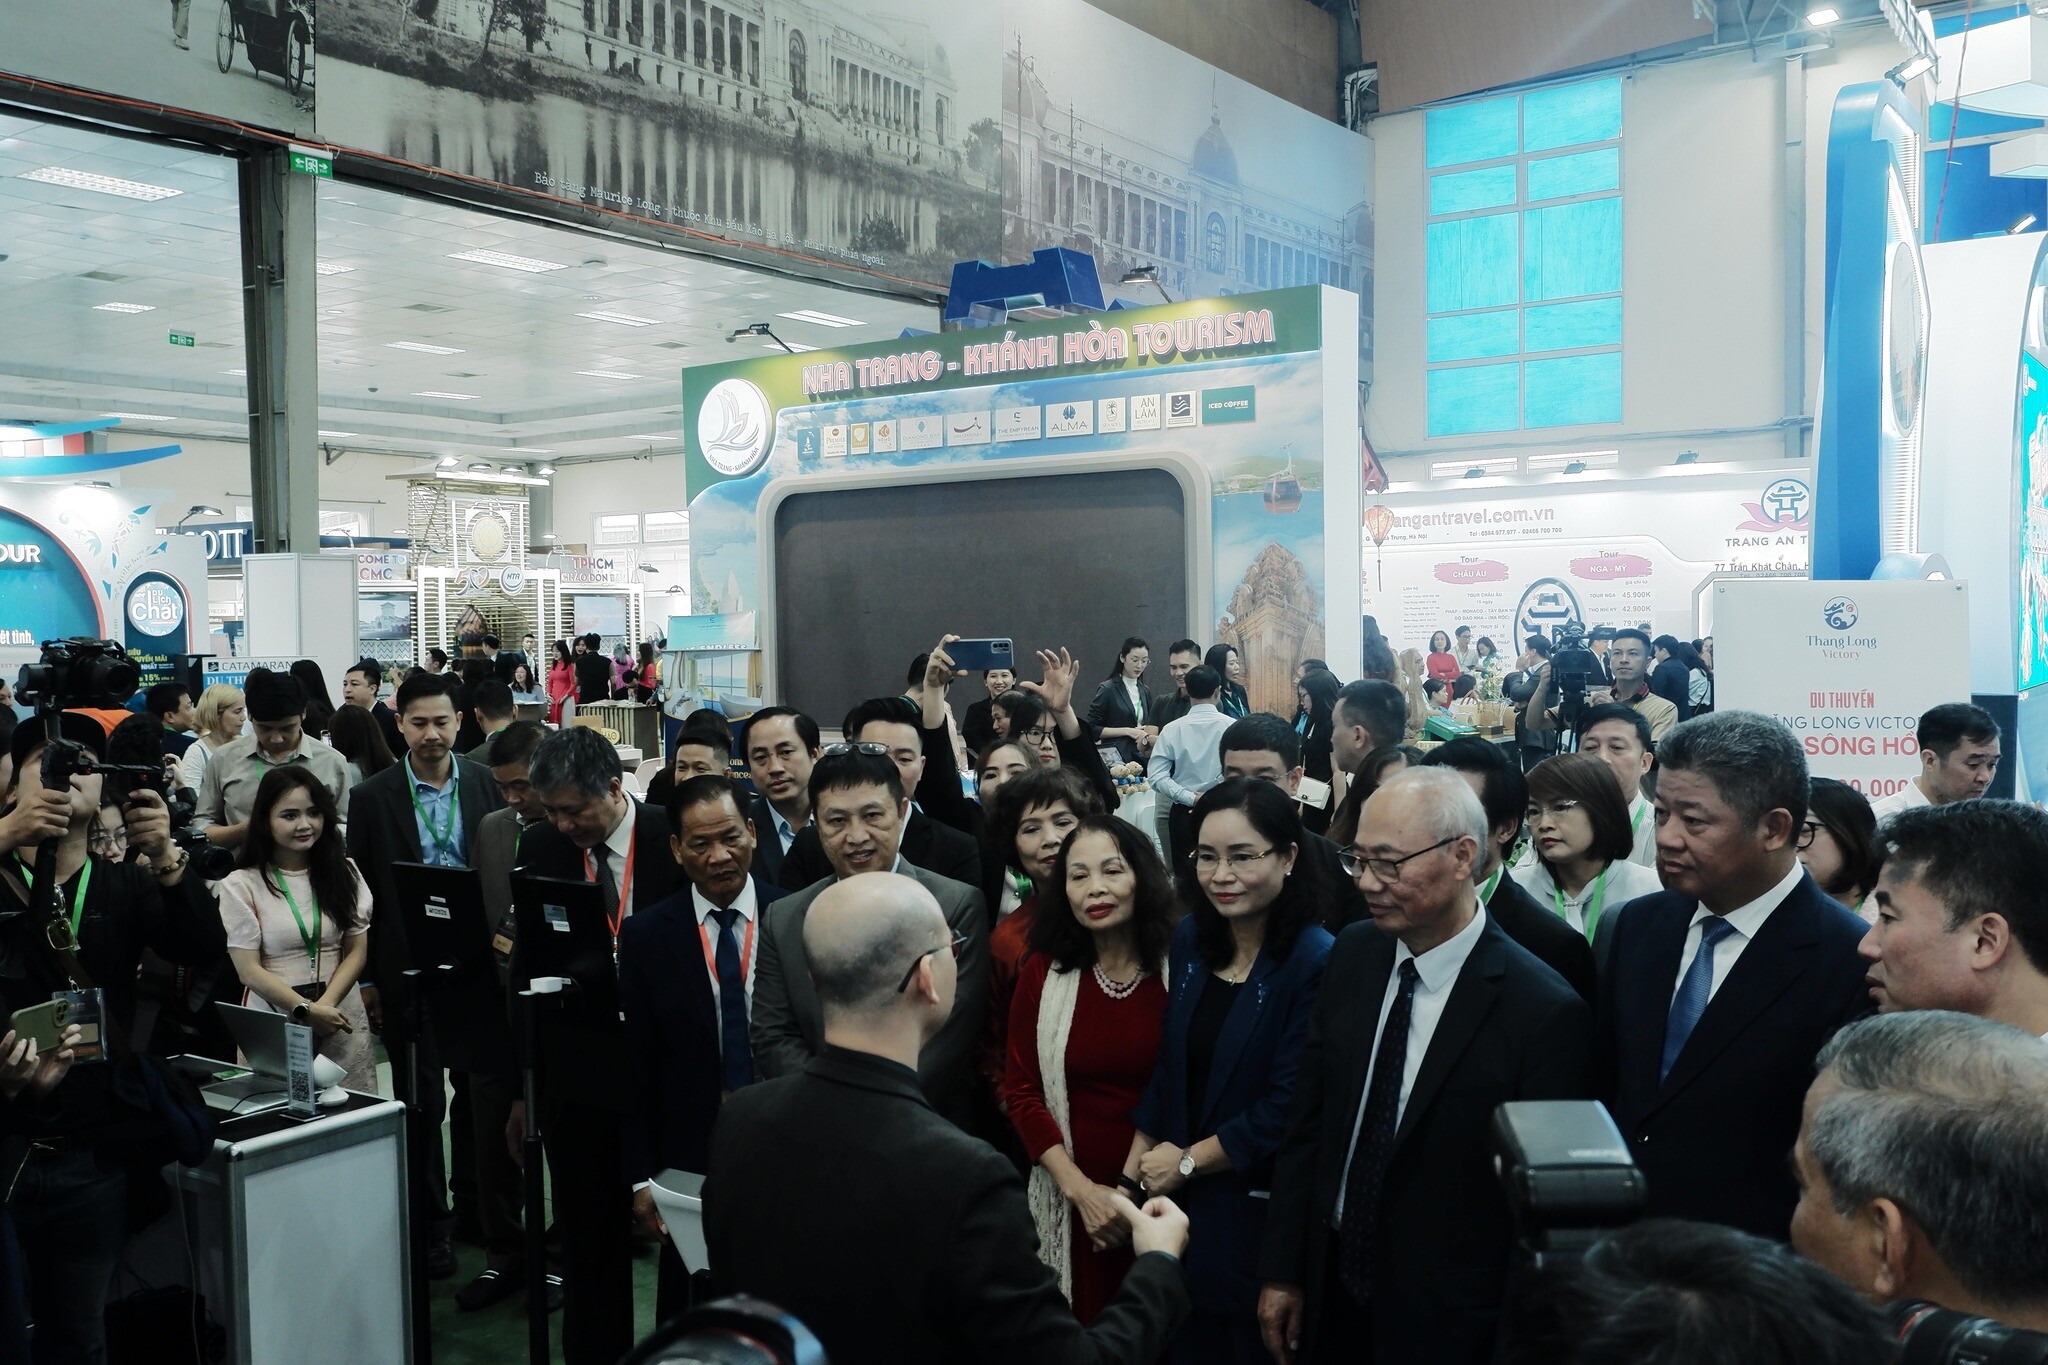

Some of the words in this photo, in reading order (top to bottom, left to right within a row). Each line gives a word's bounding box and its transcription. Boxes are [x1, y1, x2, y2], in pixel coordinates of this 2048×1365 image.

[535, 171, 556, 187] Bảo
[560, 179, 587, 198] tàng
[590, 186, 633, 206] Maurice
[637, 197, 661, 216] Long
[704, 213, 722, 227] Khu
[801, 361, 854, 395] NHA
[855, 350, 943, 388] TRANG
[964, 330, 1058, 376] KHÁNH
[1063, 320, 1128, 364] HÒA
[1132, 308, 1276, 357] TOURISM
[1141, 397, 1155, 407] AN
[1224, 399, 1249, 408] COFFEE
[1051, 420, 1088, 432] ALMA
[1393, 507, 1555, 530] angantravel.com.vn
[1725, 537, 1769, 547] TRANG
[1775, 535, 1796, 546] AN
[1800, 535, 1808, 544] T
[358, 554, 390, 564] COME
[1599, 550, 1620, 558] Tour
[572, 557, 614, 570] TPHCM
[1590, 565, 1608, 573] NGA
[1614, 563, 1628, 572] MỸ
[1715, 563, 1725, 572] 77
[359, 567, 393, 580] CMC
[1452, 569, 1475, 578] CHÂU
[1476, 568, 1487, 577] ÂU
[1806, 635, 1845, 649] Thang
[1847, 635, 1877, 649] Long
[1822, 649, 1862, 660] Victory
[1810, 692, 1825, 708] DU
[1829, 688, 1874, 709] THUYỀN
[1813, 716, 1860, 729] LONG
[1864, 716, 1921, 729] VICTO
[1804, 732, 1876, 756] SÔNG
[1883, 730, 1919, 756] HỒ
